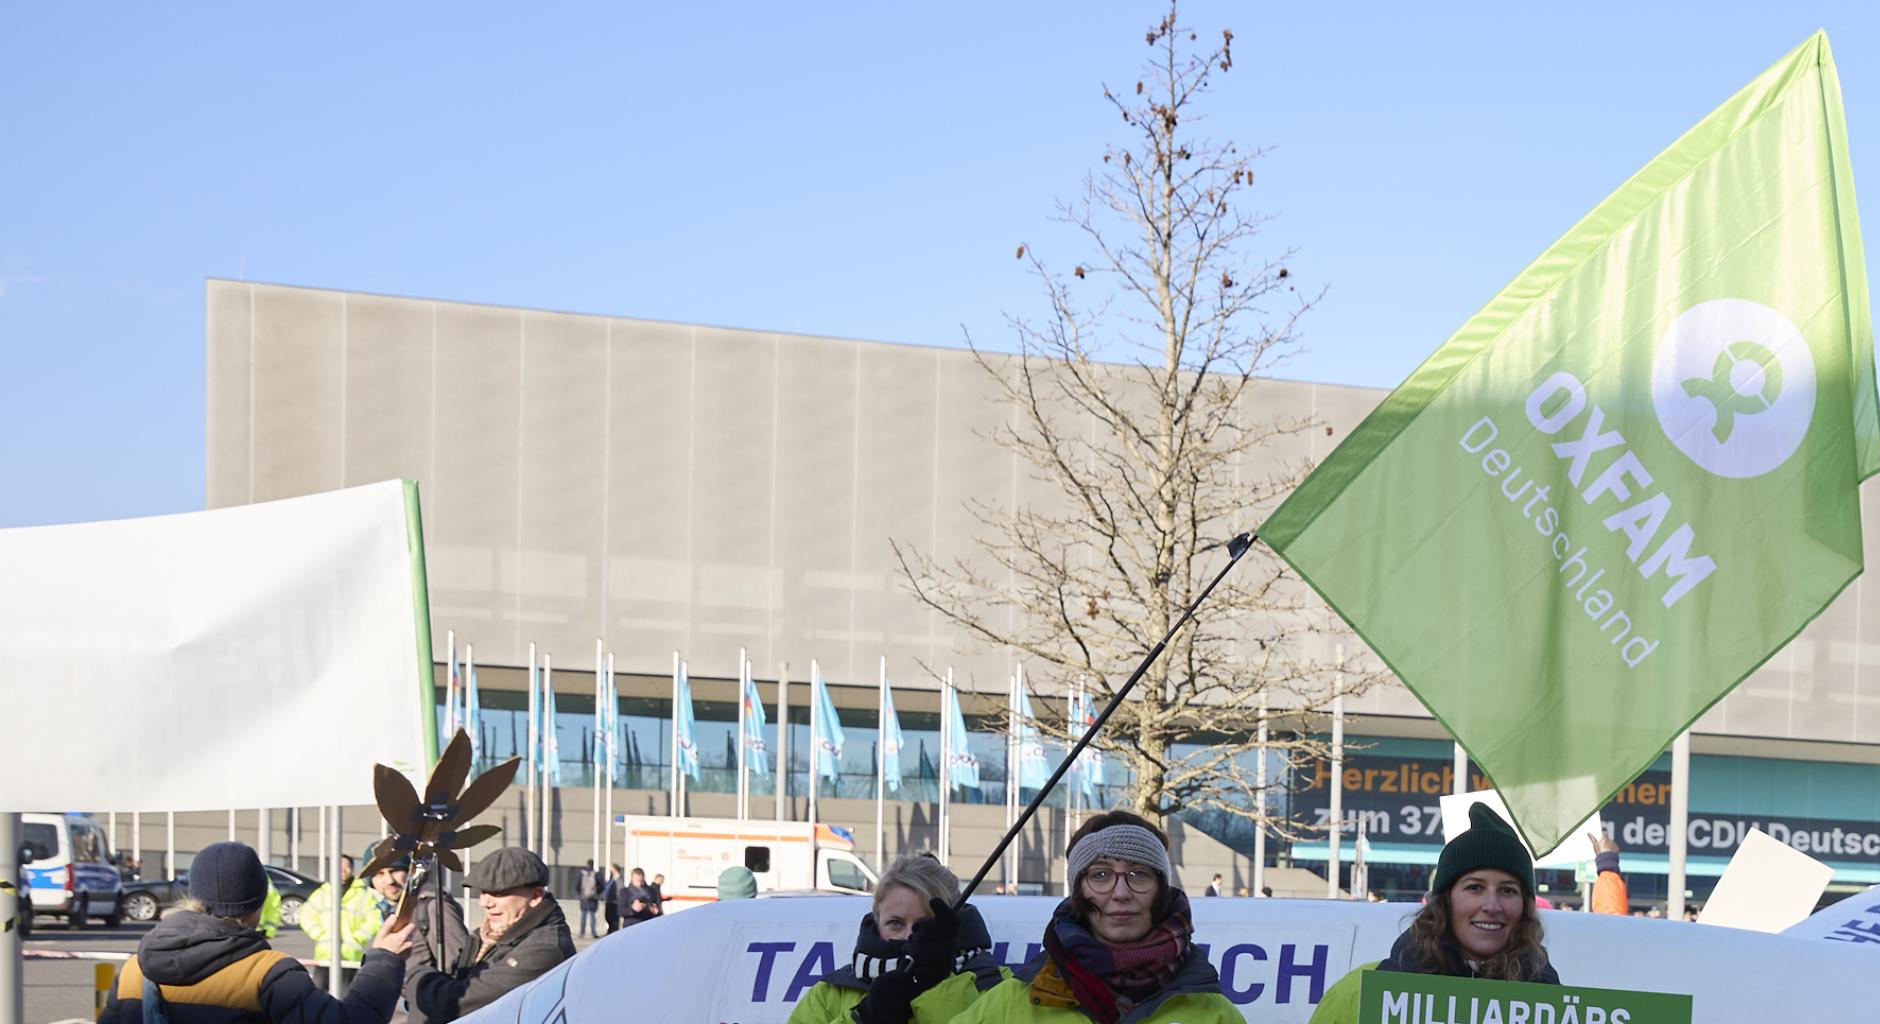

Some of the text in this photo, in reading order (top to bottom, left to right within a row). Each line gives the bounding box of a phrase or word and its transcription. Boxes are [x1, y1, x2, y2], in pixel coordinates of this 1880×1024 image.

[1459, 414, 1660, 669] Deutschland
[1525, 371, 1716, 609] OXFAM
[747, 941, 835, 1003] TA
